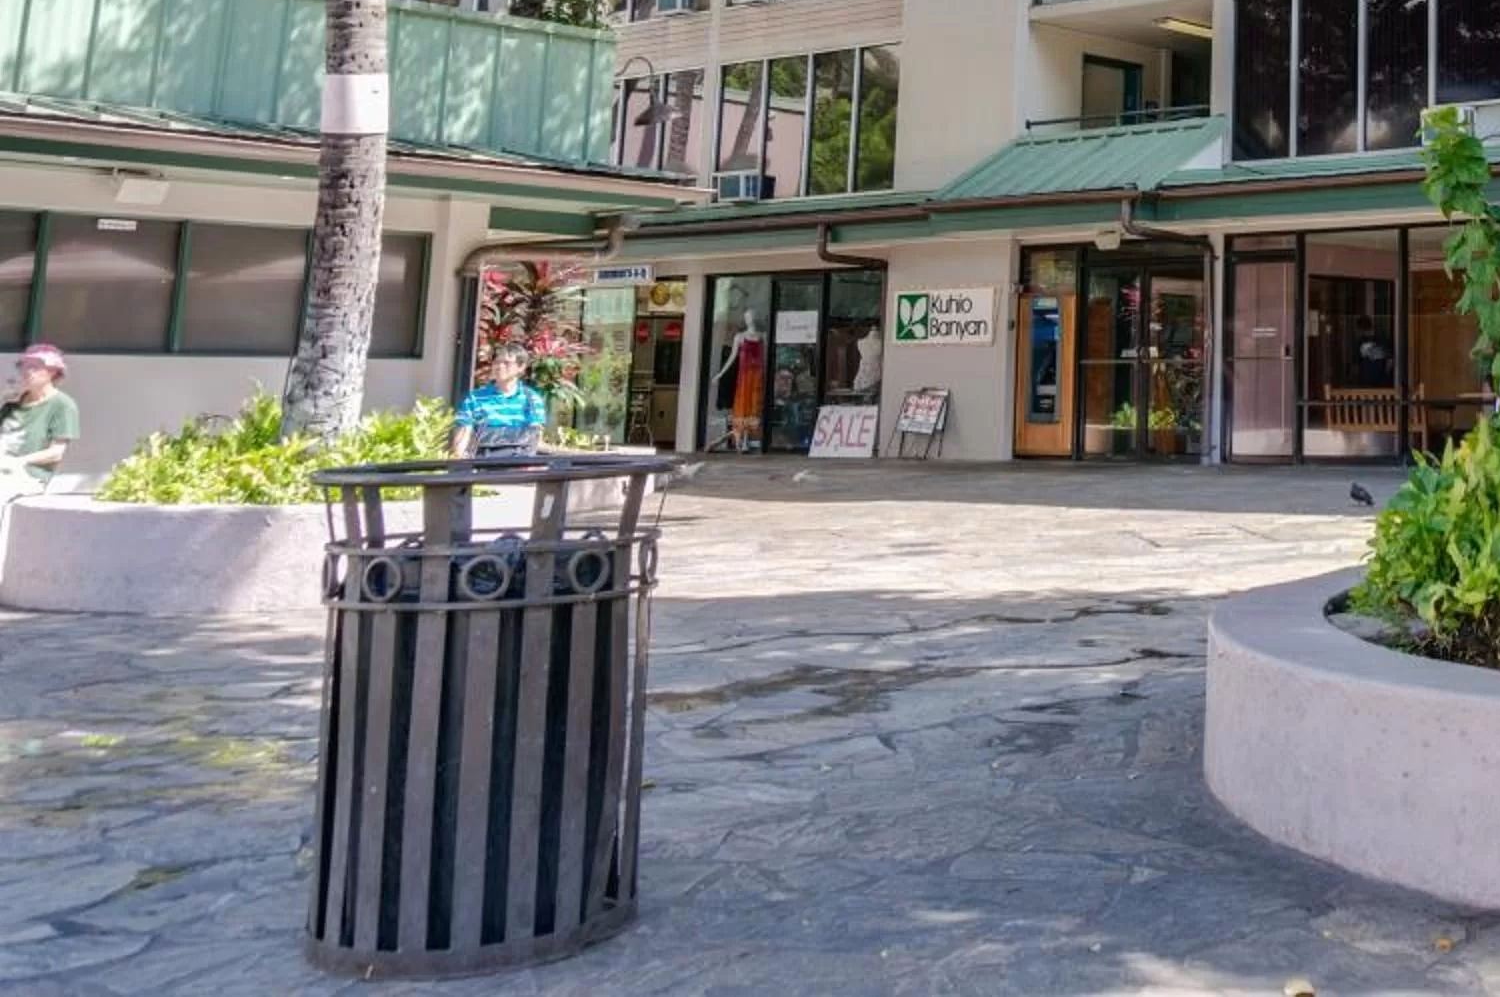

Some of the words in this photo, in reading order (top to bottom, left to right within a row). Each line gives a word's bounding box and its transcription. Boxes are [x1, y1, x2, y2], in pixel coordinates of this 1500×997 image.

[930, 293, 973, 314] Kuhio
[930, 317, 988, 340] Banyan
[813, 414, 875, 449] SALE
